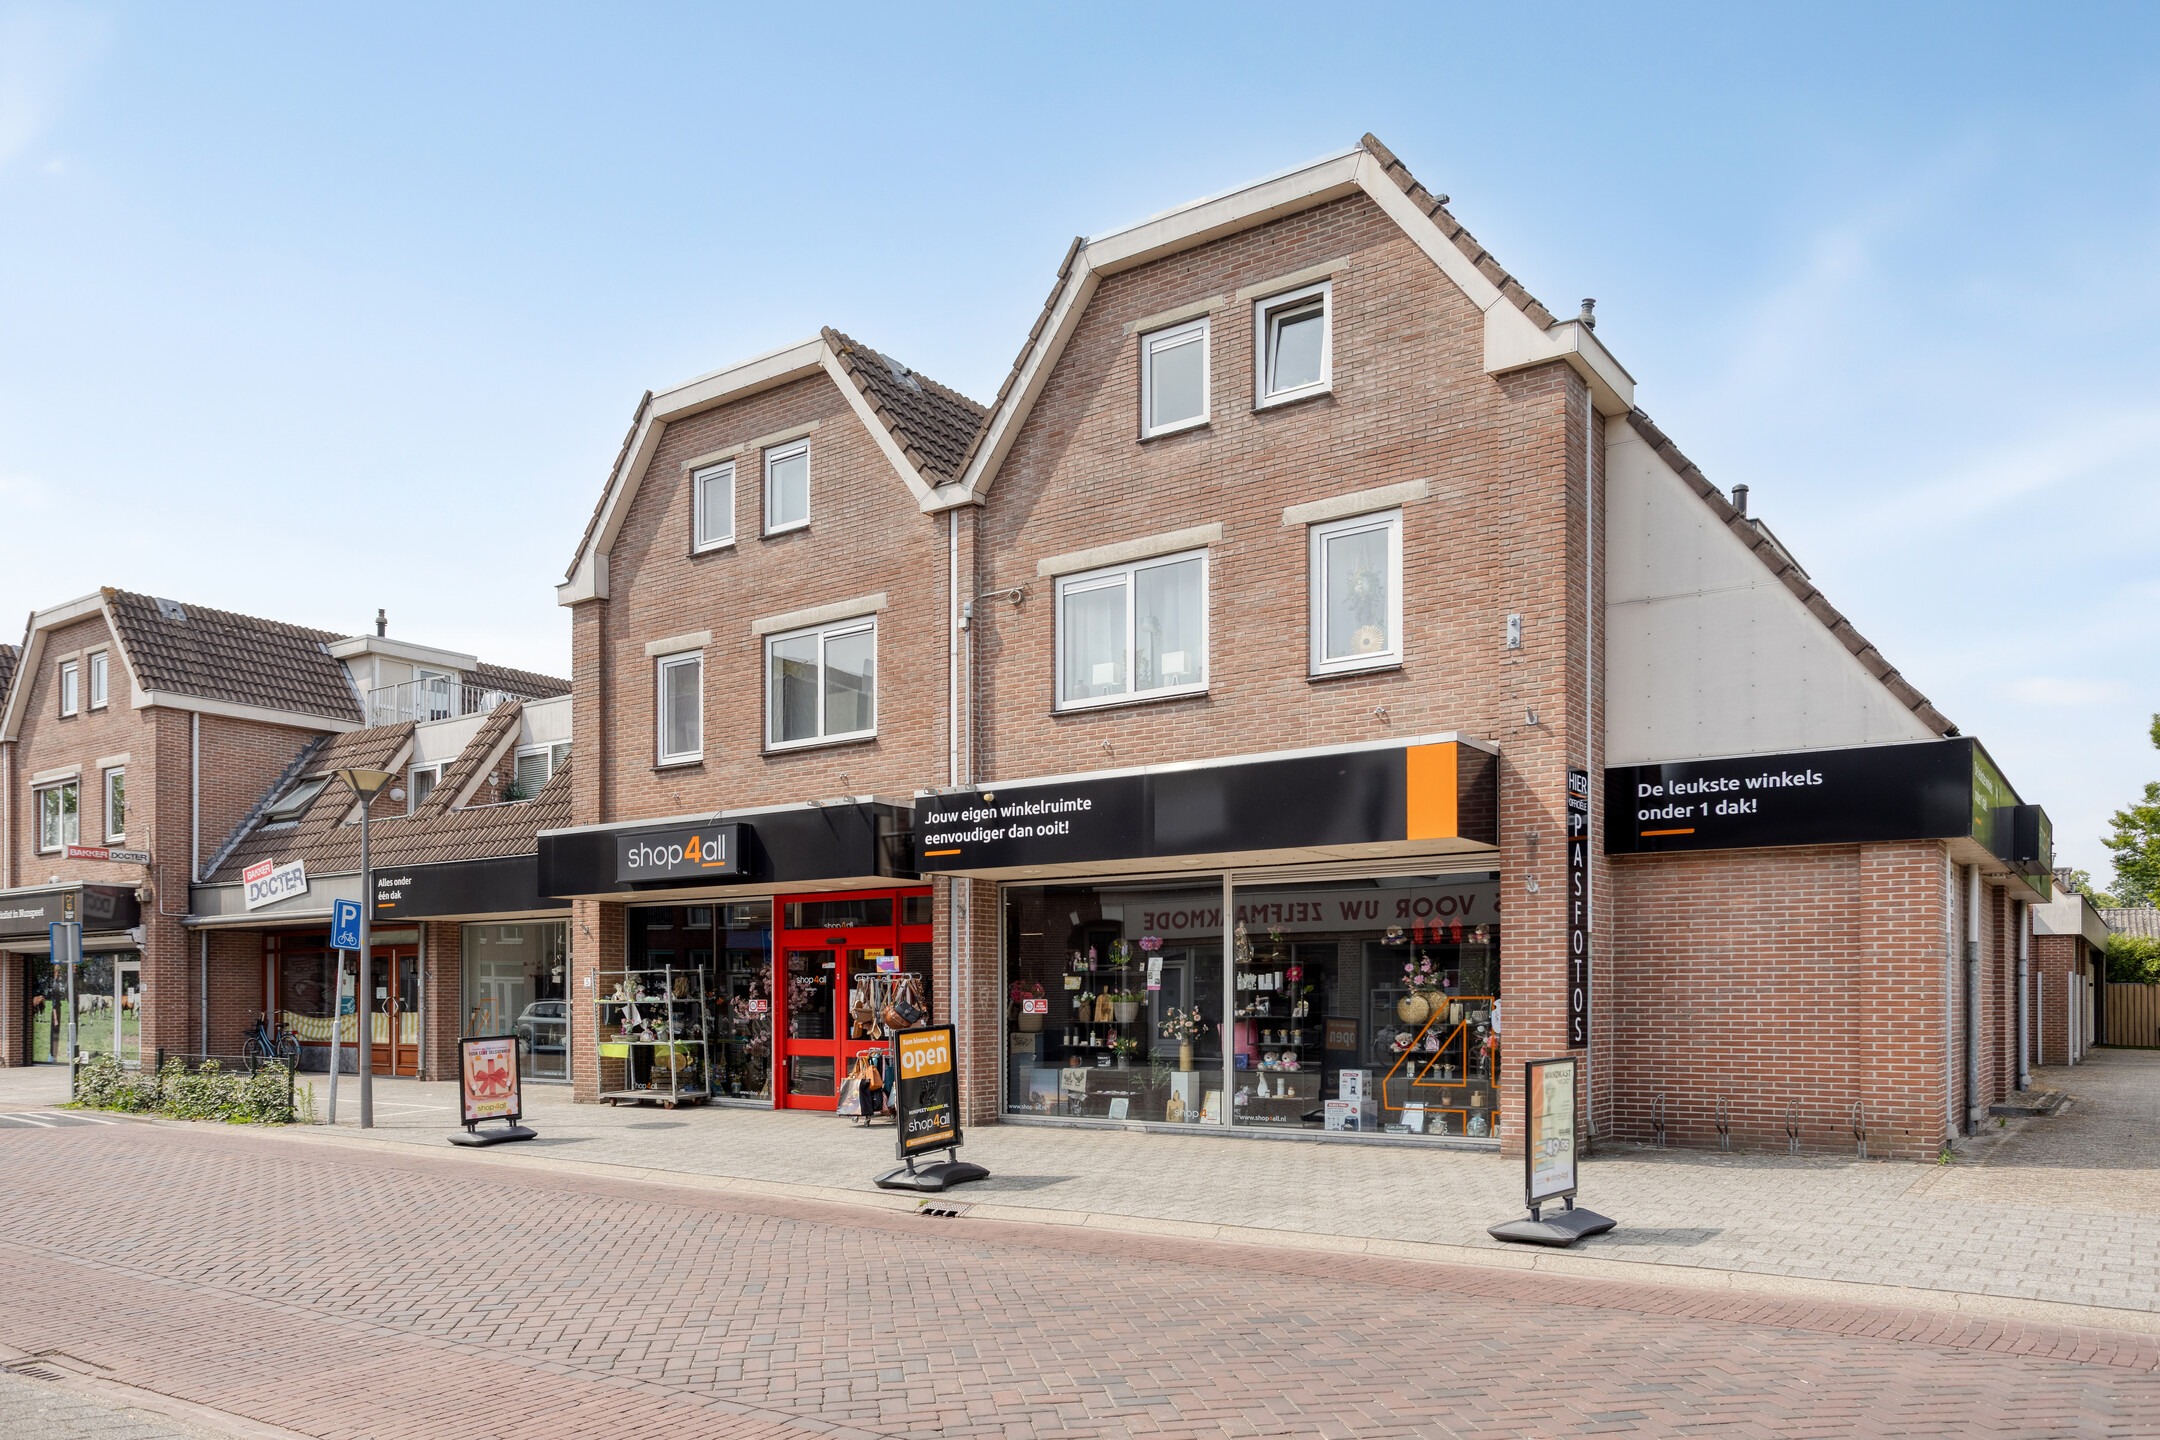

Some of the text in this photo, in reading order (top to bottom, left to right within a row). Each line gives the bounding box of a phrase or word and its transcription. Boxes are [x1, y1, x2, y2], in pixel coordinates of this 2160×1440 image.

[1568, 771, 1588, 795] HIER
[1638, 769, 1823, 797] De leukste winkels
[924, 797, 1092, 825] Jouw eigen winkelruimte
[1638, 798, 1758, 821] onder 1 dak!
[924, 820, 1070, 845] eenvoudiger dan ooit!
[69, 848, 148, 861] BAKKER DOCTER
[627, 834, 726, 870] shop4all
[246, 864, 271, 882] BAKKER
[249, 867, 304, 902] DOCTER
[377, 876, 412, 888] Alles onder
[377, 890, 402, 901] één dak
[340, 904, 357, 929] P
[1573, 813, 1583, 1042] PASFOTOS
[796, 975, 827, 985] shop4all
[902, 1046, 947, 1072] open
[634, 1082, 658, 1090] hop4all
[908, 1112, 951, 1132] shop4all
[1239, 1114, 1287, 1122] www.shop4all.nl
